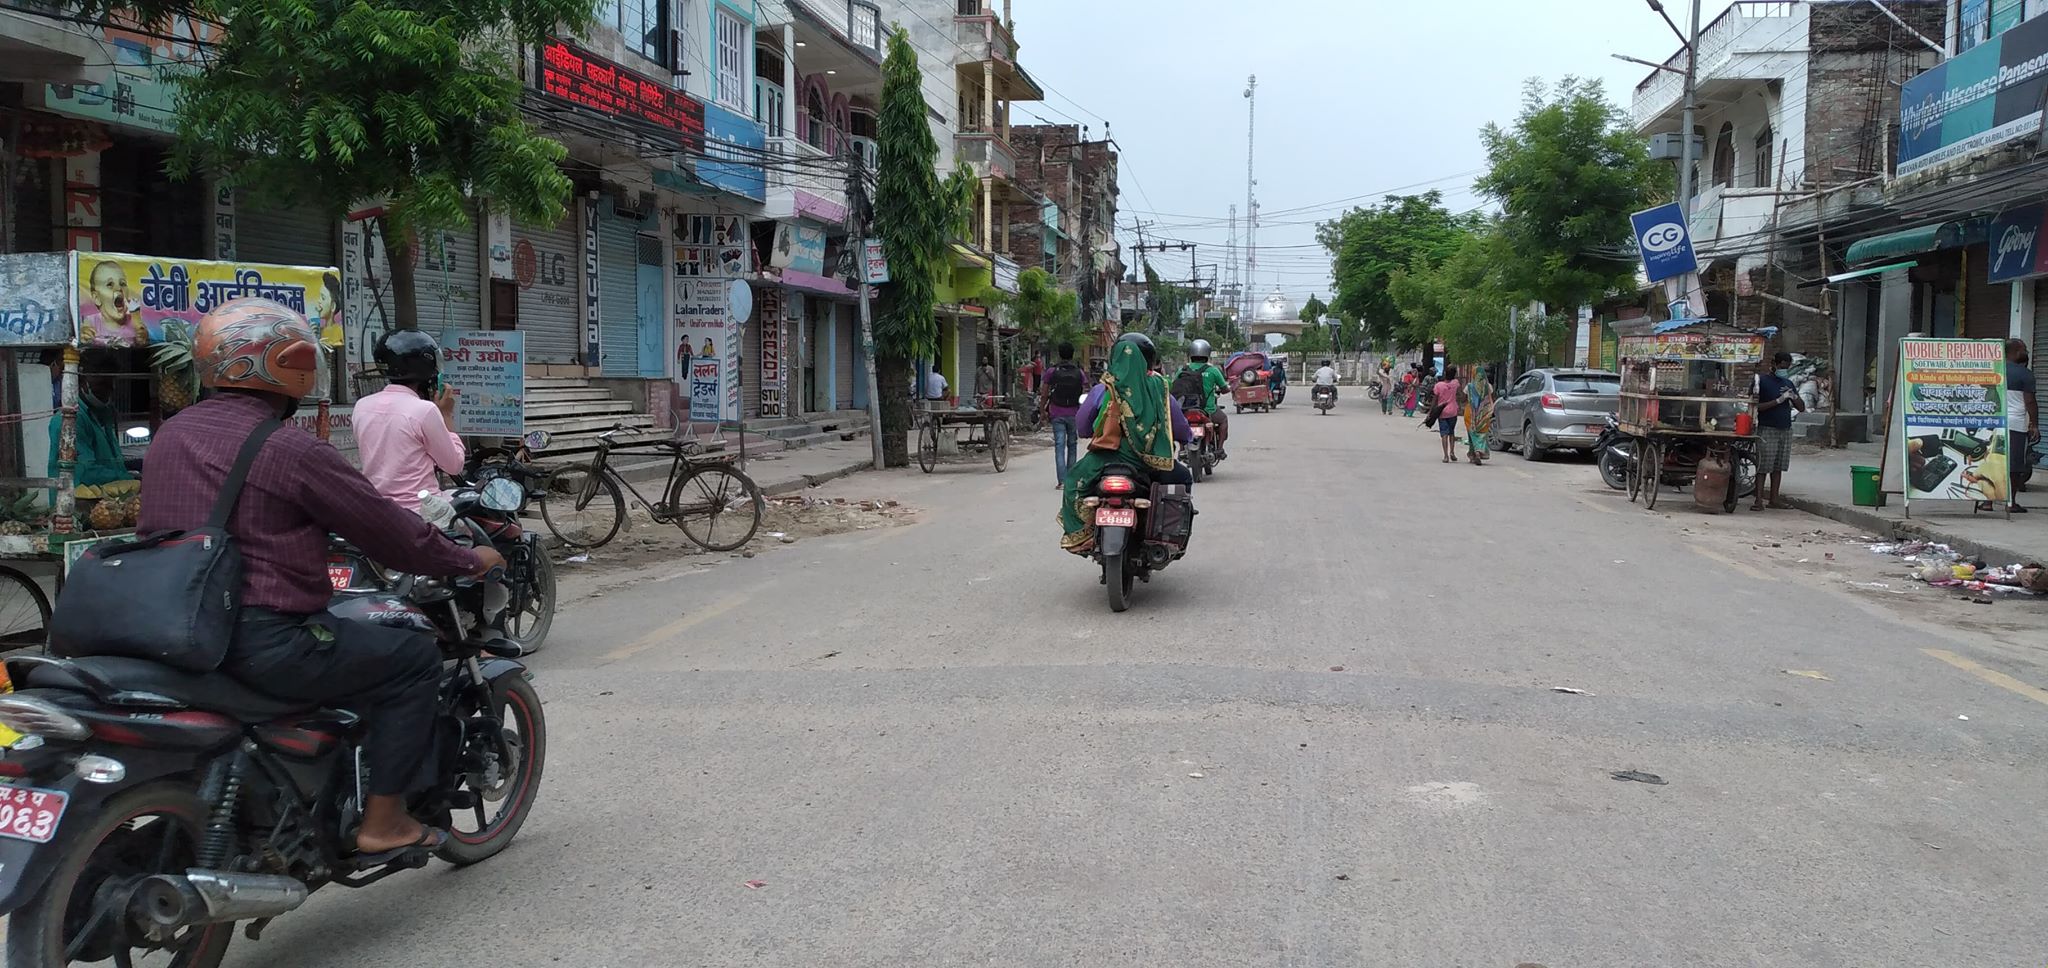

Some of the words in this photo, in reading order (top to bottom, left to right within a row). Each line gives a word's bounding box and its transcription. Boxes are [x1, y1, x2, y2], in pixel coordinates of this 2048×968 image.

[1945, 77, 1998, 110] Hisense
[1901, 90, 1945, 134] Whirlpool
[1648, 227, 1678, 246] CG
[1993, 225, 2037, 273] Godrej
[541, 251, 565, 285] LG
[676, 304, 698, 315] Lalan
[698, 304, 724, 315] Traders
[676, 319, 685, 327] The
[1905, 342, 1943, 359] MOBILE
[1946, 343, 2001, 359] REPAIRING
[694, 364, 717, 377] ललन
[1914, 361, 1947, 369] SOFTWARE
[1956, 361, 1991, 369] HARDWARE
[1967, 375, 1996, 383] Repairing
[762, 389, 779, 401] STU
[762, 403, 779, 415] DIO
